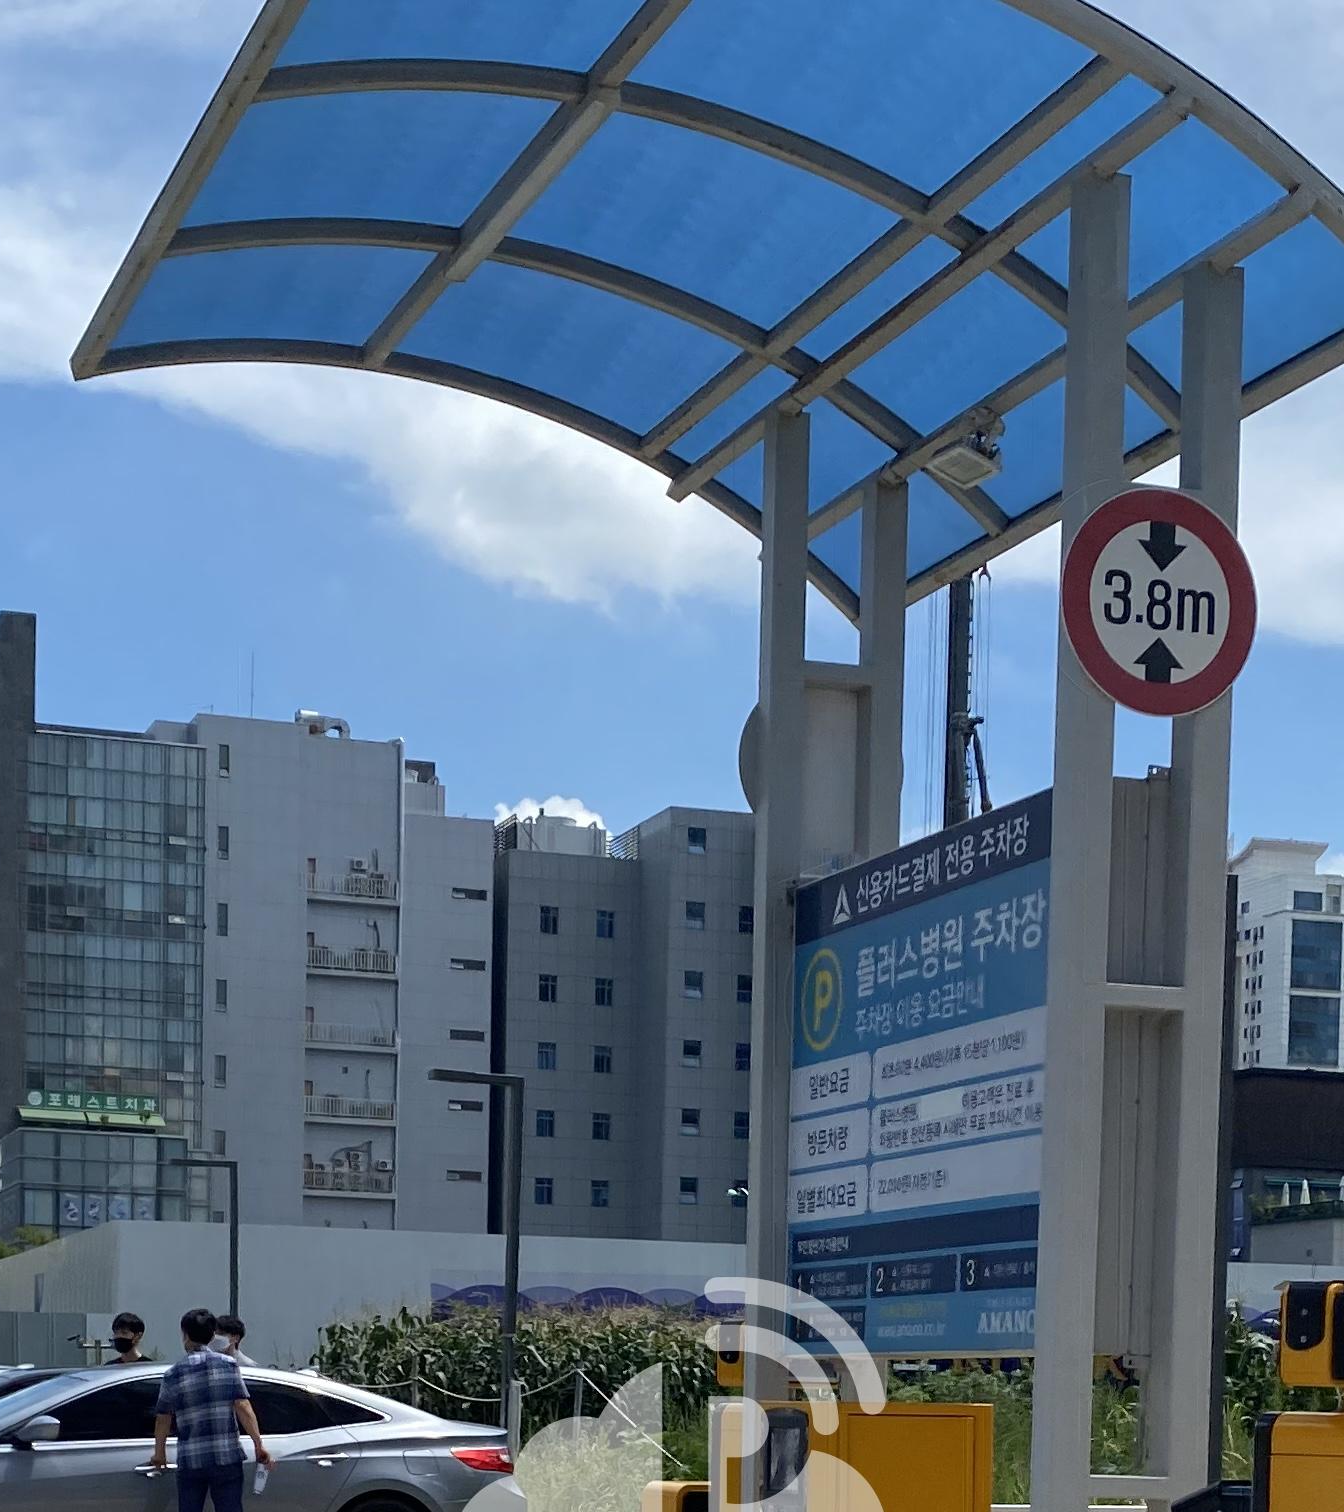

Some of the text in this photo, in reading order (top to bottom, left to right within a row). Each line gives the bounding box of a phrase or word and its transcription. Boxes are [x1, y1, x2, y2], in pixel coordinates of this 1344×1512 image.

[1103, 568, 1216, 635] 3.8m
[856, 813, 1030, 913] 신용카드결제 전용 주차장
[856, 888, 1047, 998] 플러스병원 주차장
[855, 1003, 892, 1040] 주차장
[809, 1067, 849, 1100] 일반요금
[48, 1093, 156, 1111] 포레스트치과
[807, 1126, 849, 1157] 방문차량
[965, 1258, 977, 1287] 3
